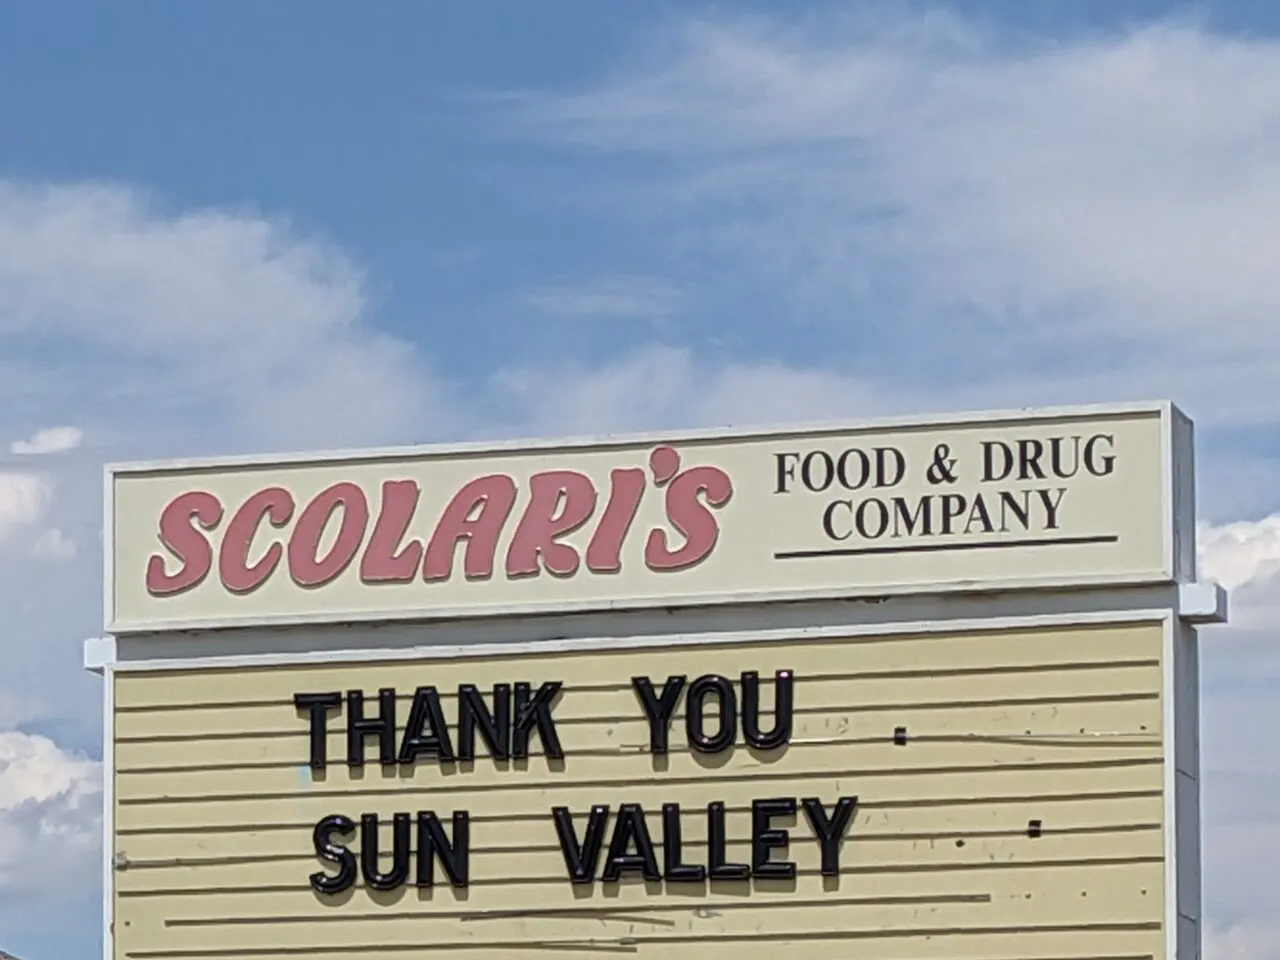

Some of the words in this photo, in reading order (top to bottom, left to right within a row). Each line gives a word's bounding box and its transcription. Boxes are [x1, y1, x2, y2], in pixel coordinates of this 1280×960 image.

[774, 446, 908, 494] FOOD
[926, 443, 959, 485] &
[980, 434, 1116, 483] DRUG
[146, 446, 733, 595] SCOLARI'S
[822, 487, 1067, 541] COMPANY
[294, 680, 565, 770] THANK
[632, 669, 794, 755] YOU
[310, 810, 470, 895] SUN
[553, 796, 859, 884] VALLEY
